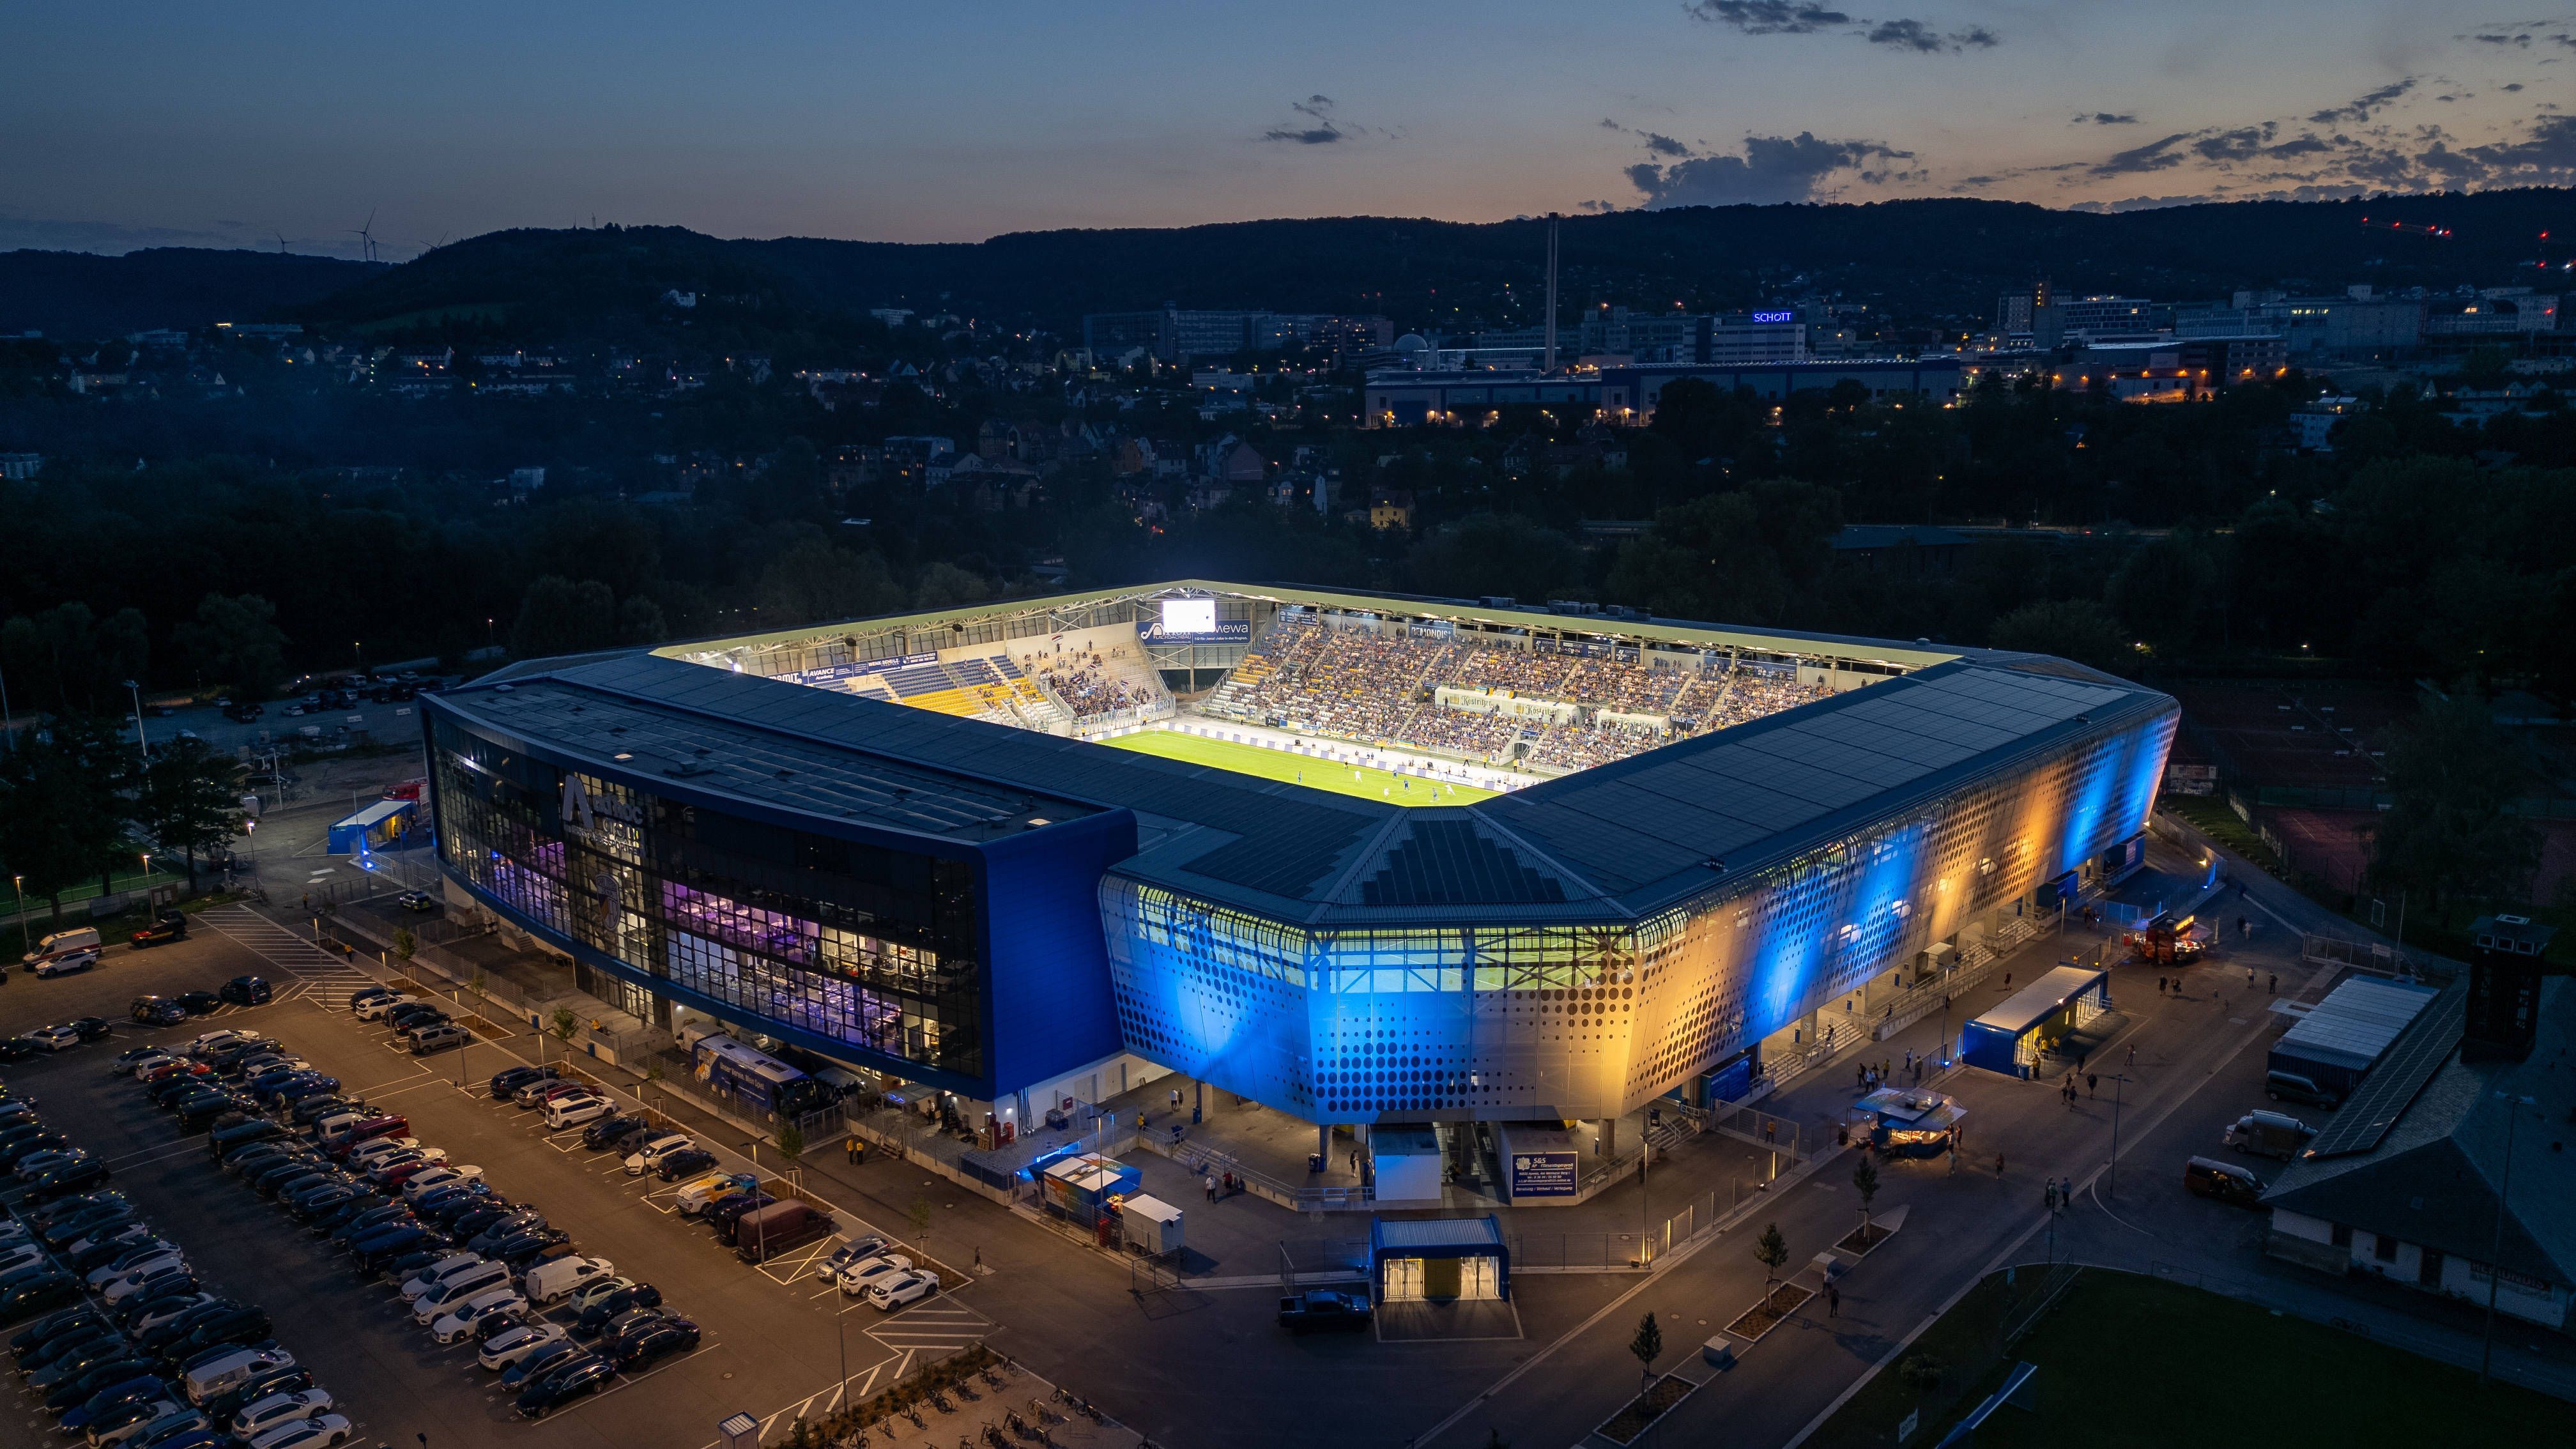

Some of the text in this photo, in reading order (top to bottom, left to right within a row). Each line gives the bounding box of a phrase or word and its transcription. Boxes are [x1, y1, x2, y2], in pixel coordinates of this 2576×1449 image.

[1754, 313, 1791, 322] SCHOTT
[809, 668, 835, 677] AVANCE
[720, 1062, 732, 1073] Unser
